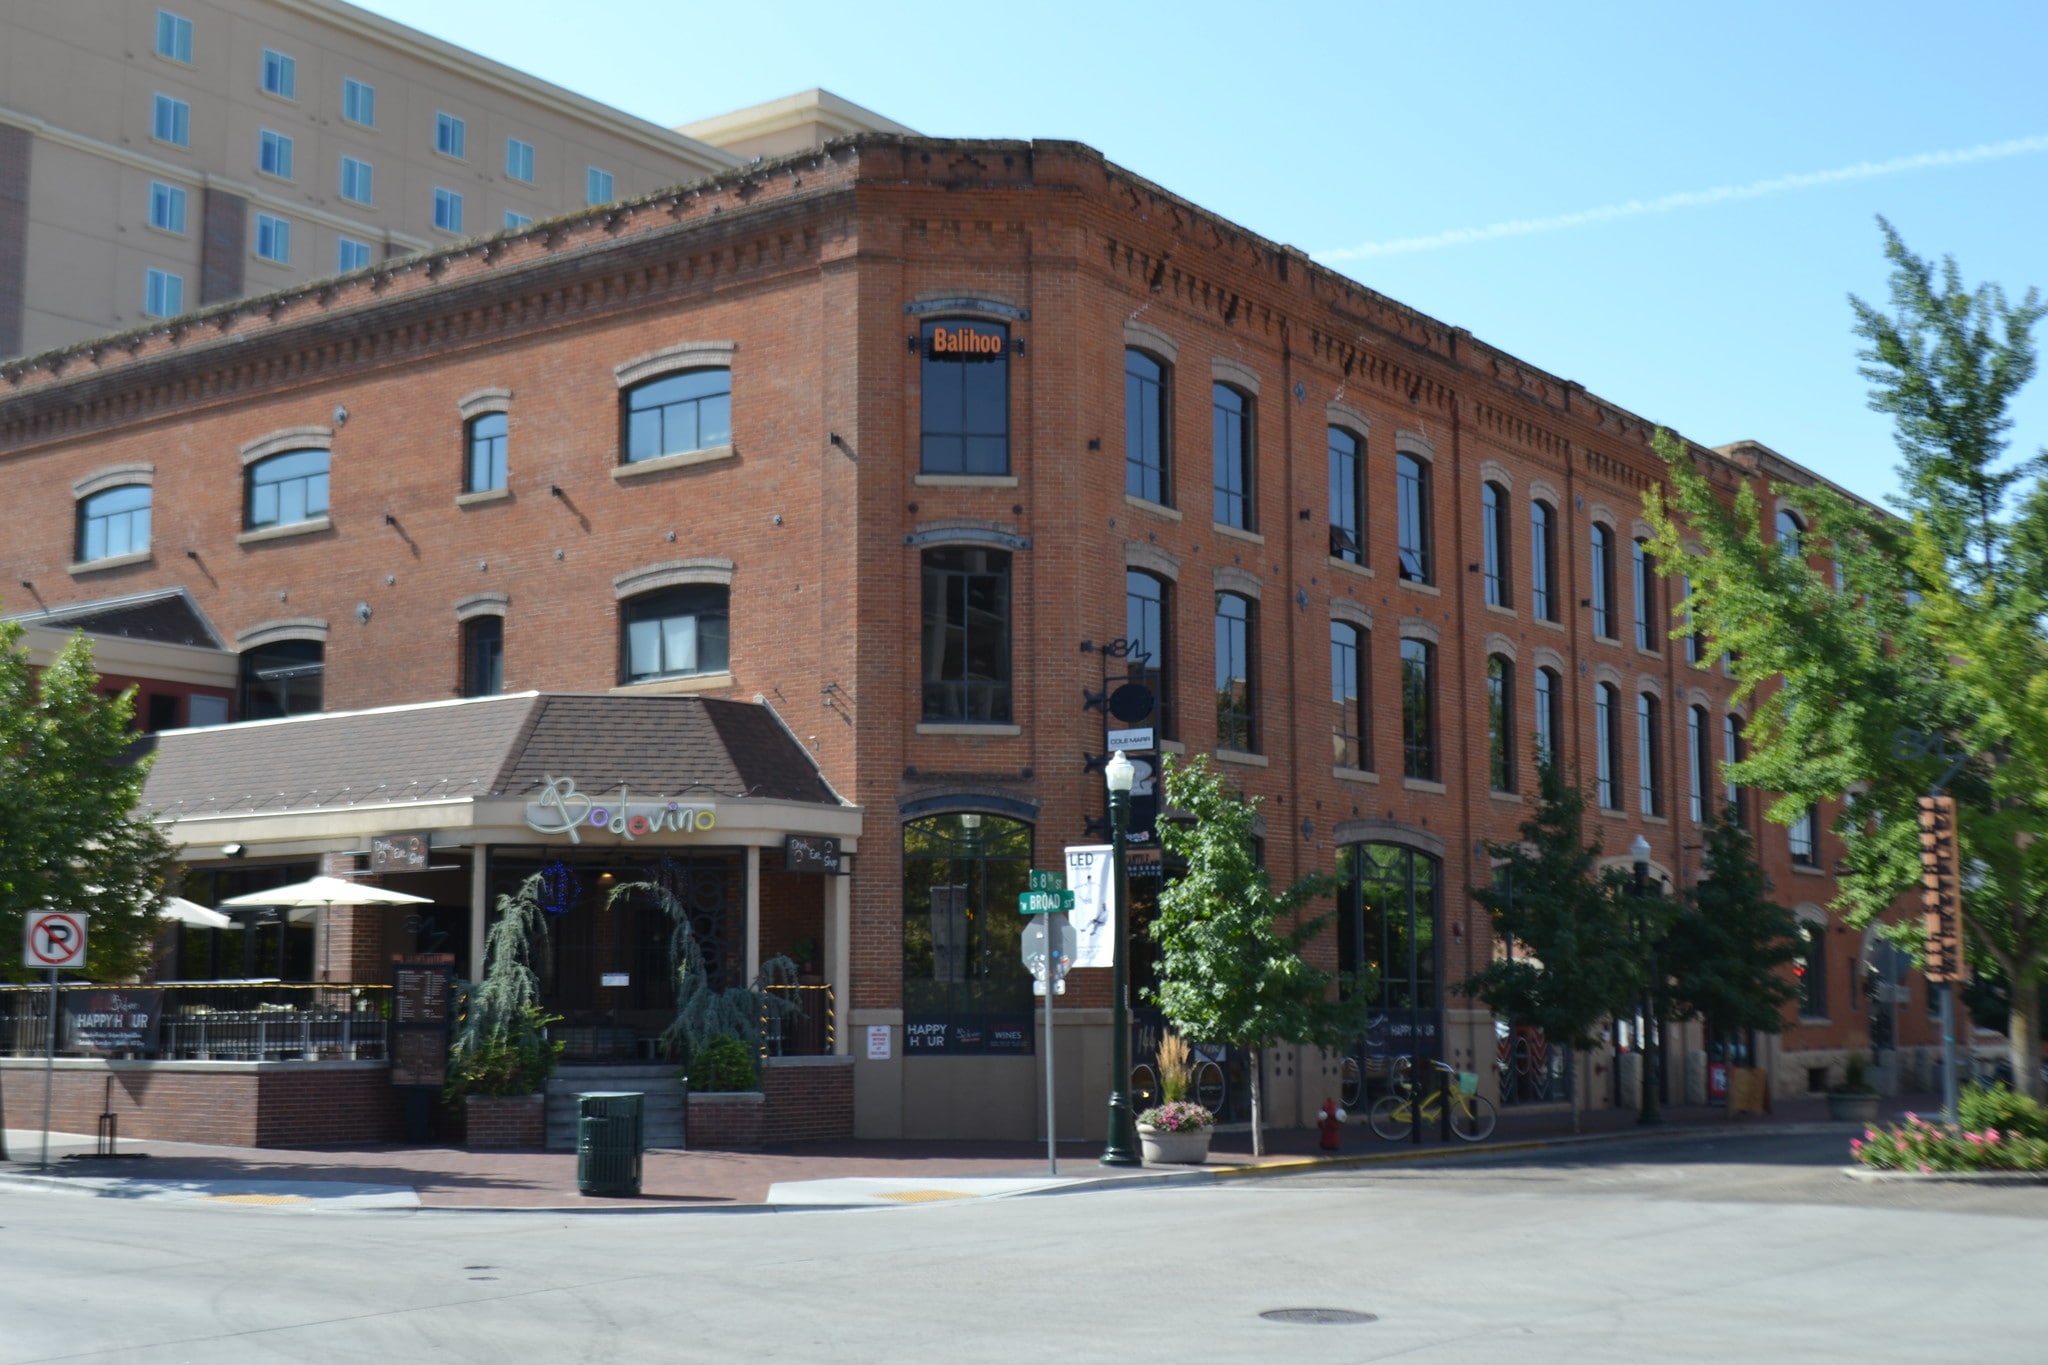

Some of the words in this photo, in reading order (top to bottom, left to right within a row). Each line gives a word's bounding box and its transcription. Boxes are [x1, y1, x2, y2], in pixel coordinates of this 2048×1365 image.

[934, 327, 1001, 353] Balihoo
[527, 775, 716, 844] Bodovino
[1070, 852, 1093, 866] LED
[1032, 877, 1038, 888] S
[1055, 879, 1062, 890] ST
[1030, 893, 1060, 911] BROAD
[1064, 899, 1072, 909] ST
[47, 925, 73, 954] P
[78, 1014, 112, 1028] HAPPY
[907, 1024, 948, 1035] HAPPY
[994, 1031, 1022, 1040] WINES
